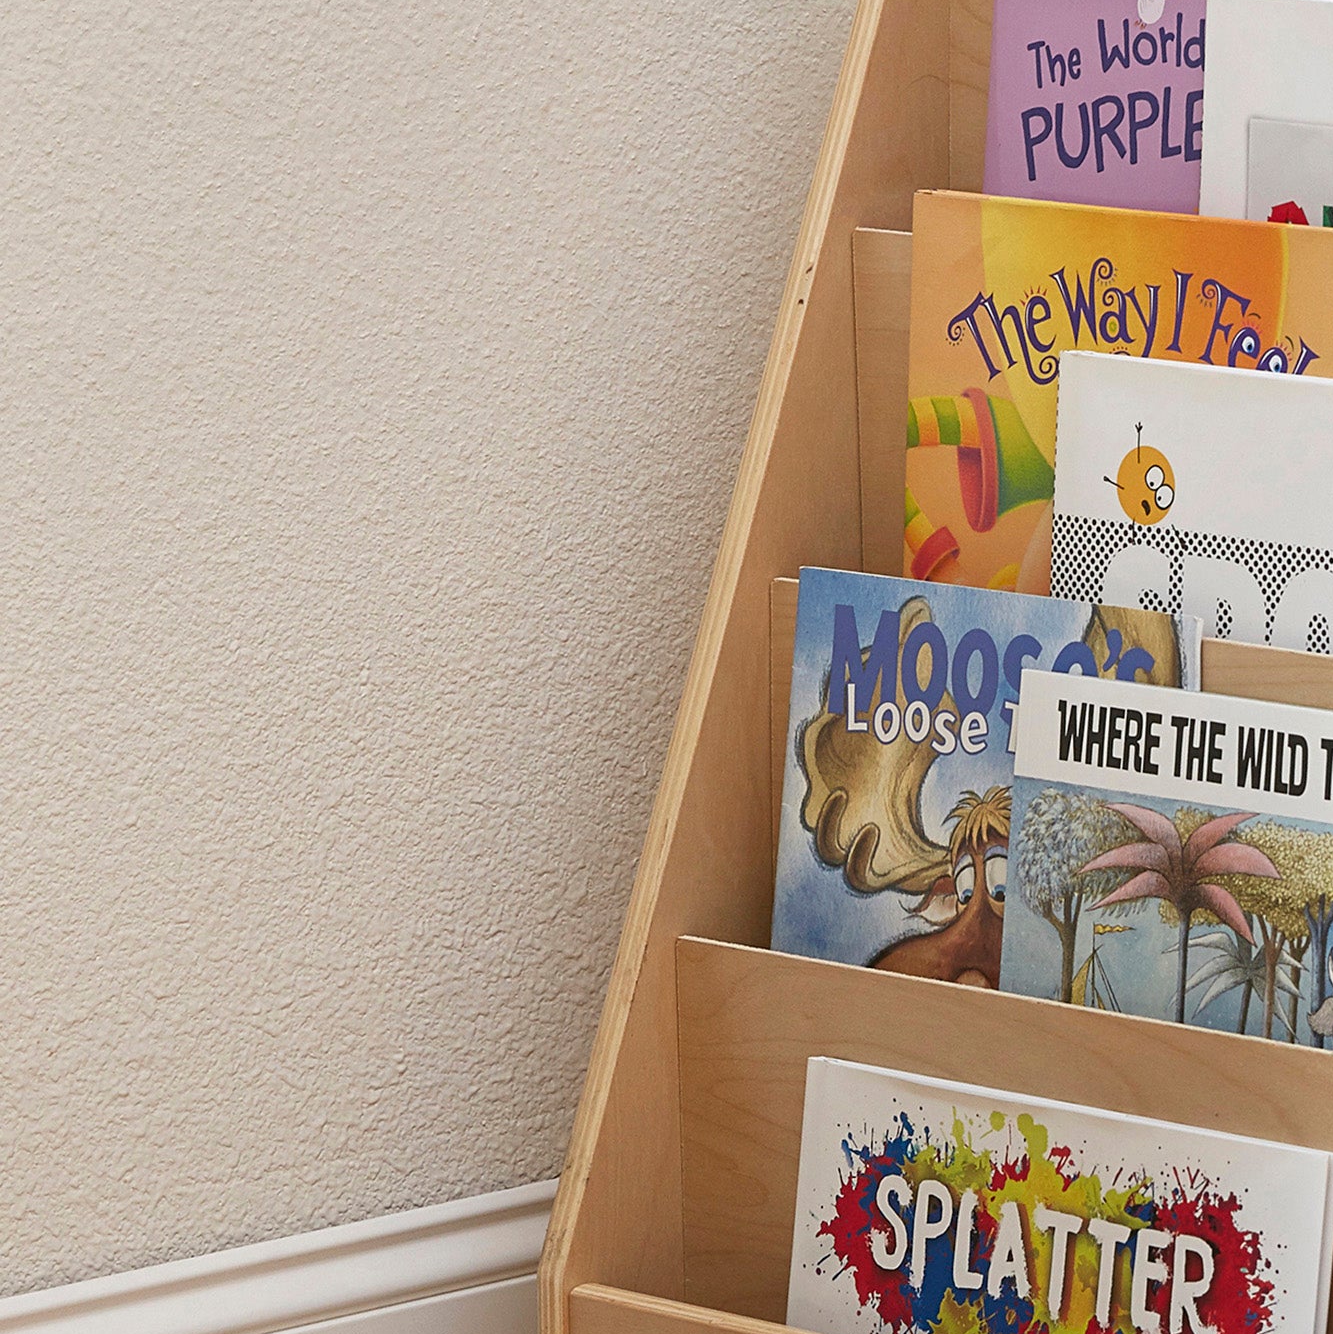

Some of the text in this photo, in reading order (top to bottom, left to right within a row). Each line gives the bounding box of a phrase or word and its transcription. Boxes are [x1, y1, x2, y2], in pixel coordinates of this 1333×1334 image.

[1027, 12, 1206, 89] The World
[946, 290, 1060, 386] The
[1050, 257, 1162, 358] Way
[1166, 268, 1194, 354] I
[847, 683, 989, 755] Loose
[1057, 699, 1162, 775] WHERE
[1170, 714, 1226, 784] THE
[1237, 725, 1309, 796] WILD
